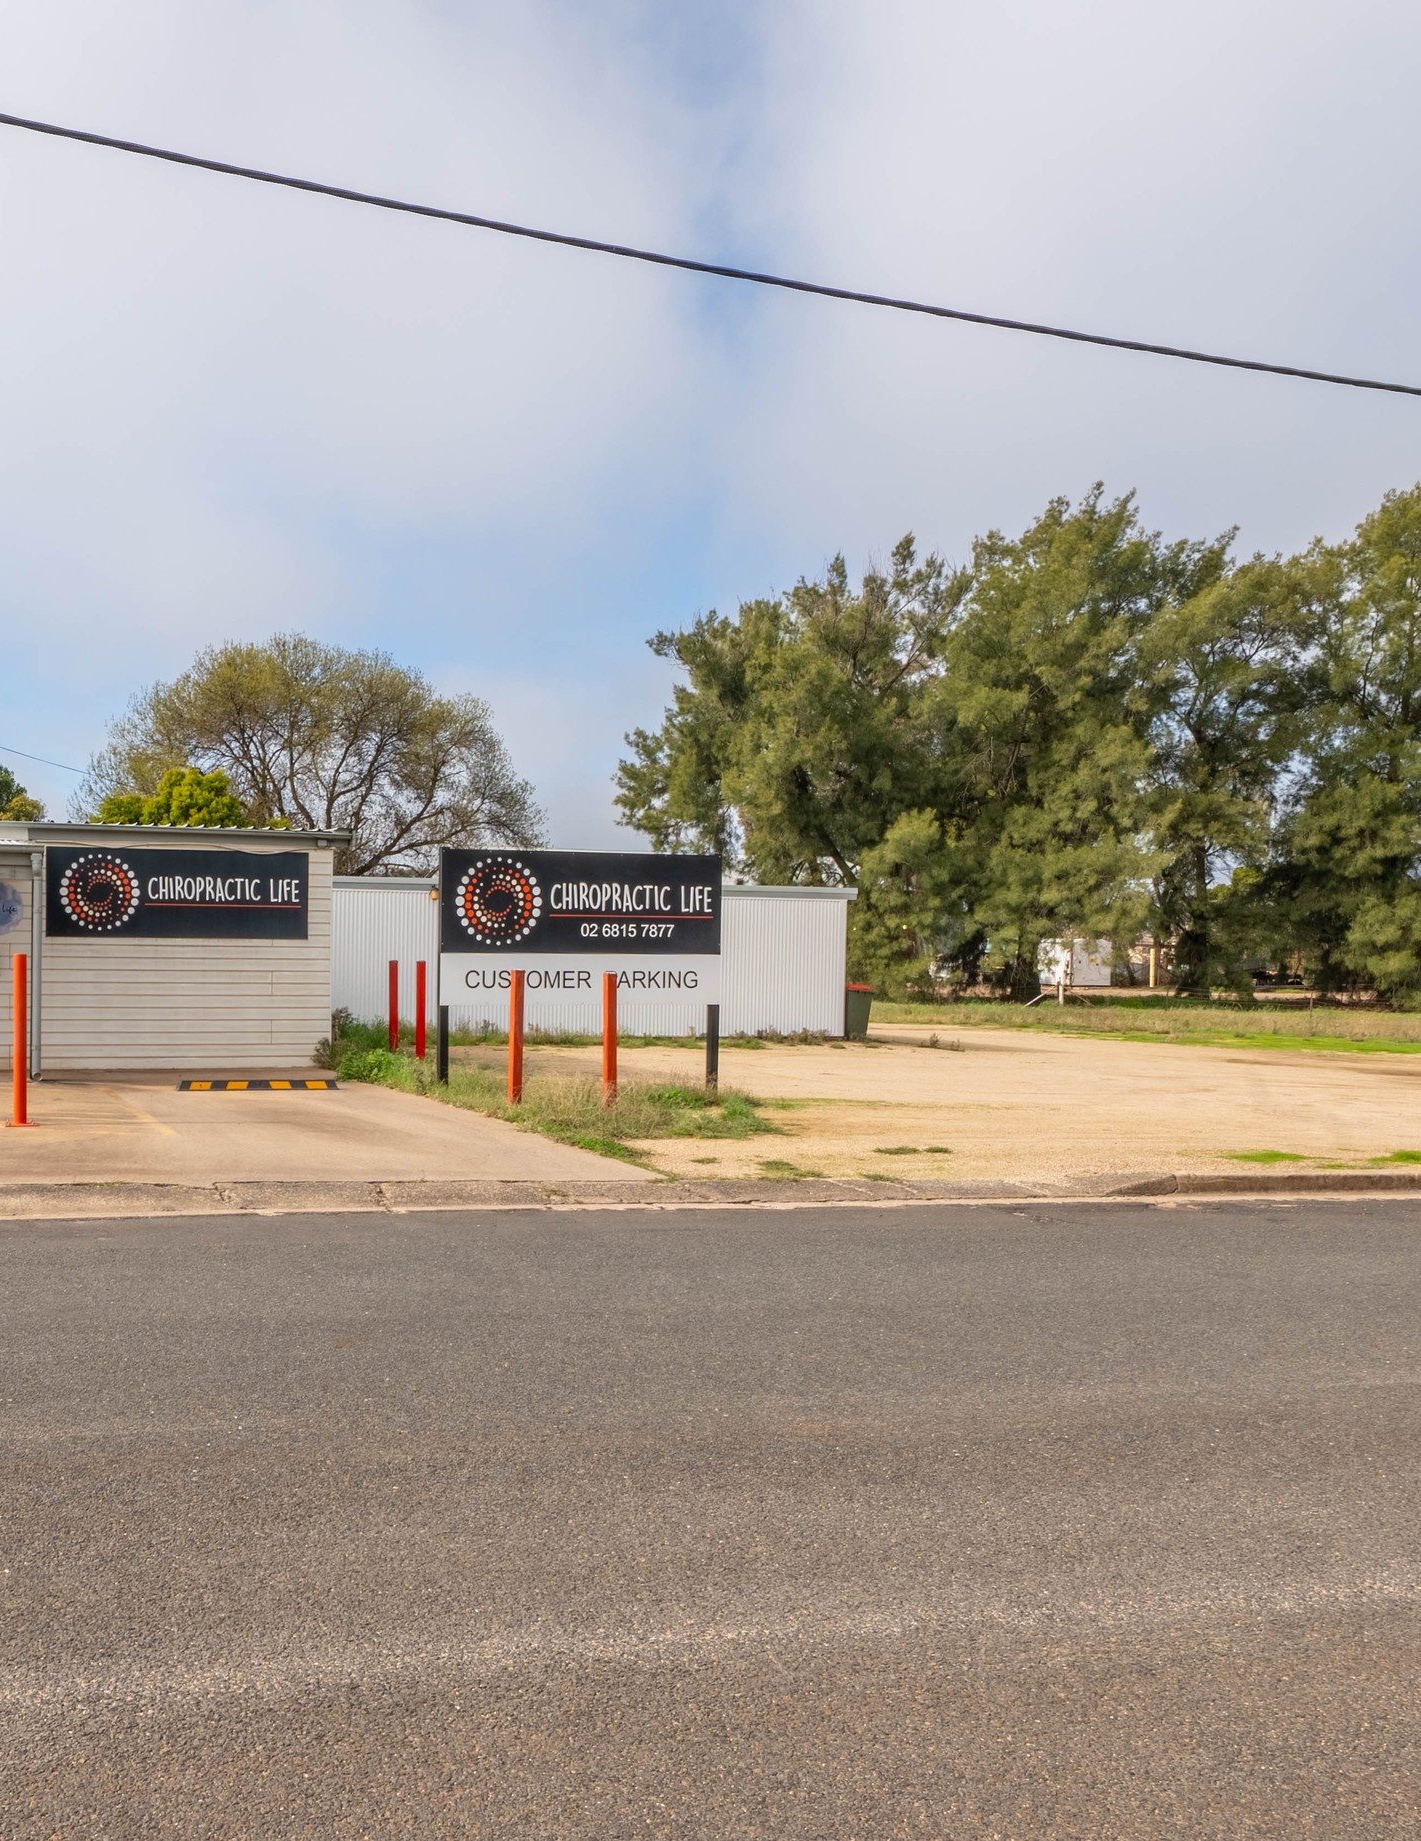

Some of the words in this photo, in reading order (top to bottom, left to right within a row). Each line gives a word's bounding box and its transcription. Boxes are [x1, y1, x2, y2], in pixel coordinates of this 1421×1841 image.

[147, 876, 261, 902] CHIROPRACTIC
[270, 879, 300, 903] LIFE
[550, 882, 671, 912] CHIROPRACTIC
[681, 886, 713, 913] LIFE
[580, 923, 599, 938] 02
[602, 924, 637, 938] 6815
[641, 924, 675, 939] 7877
[465, 970, 592, 989] CUSOMER
[616, 971, 698, 989] ARKING
